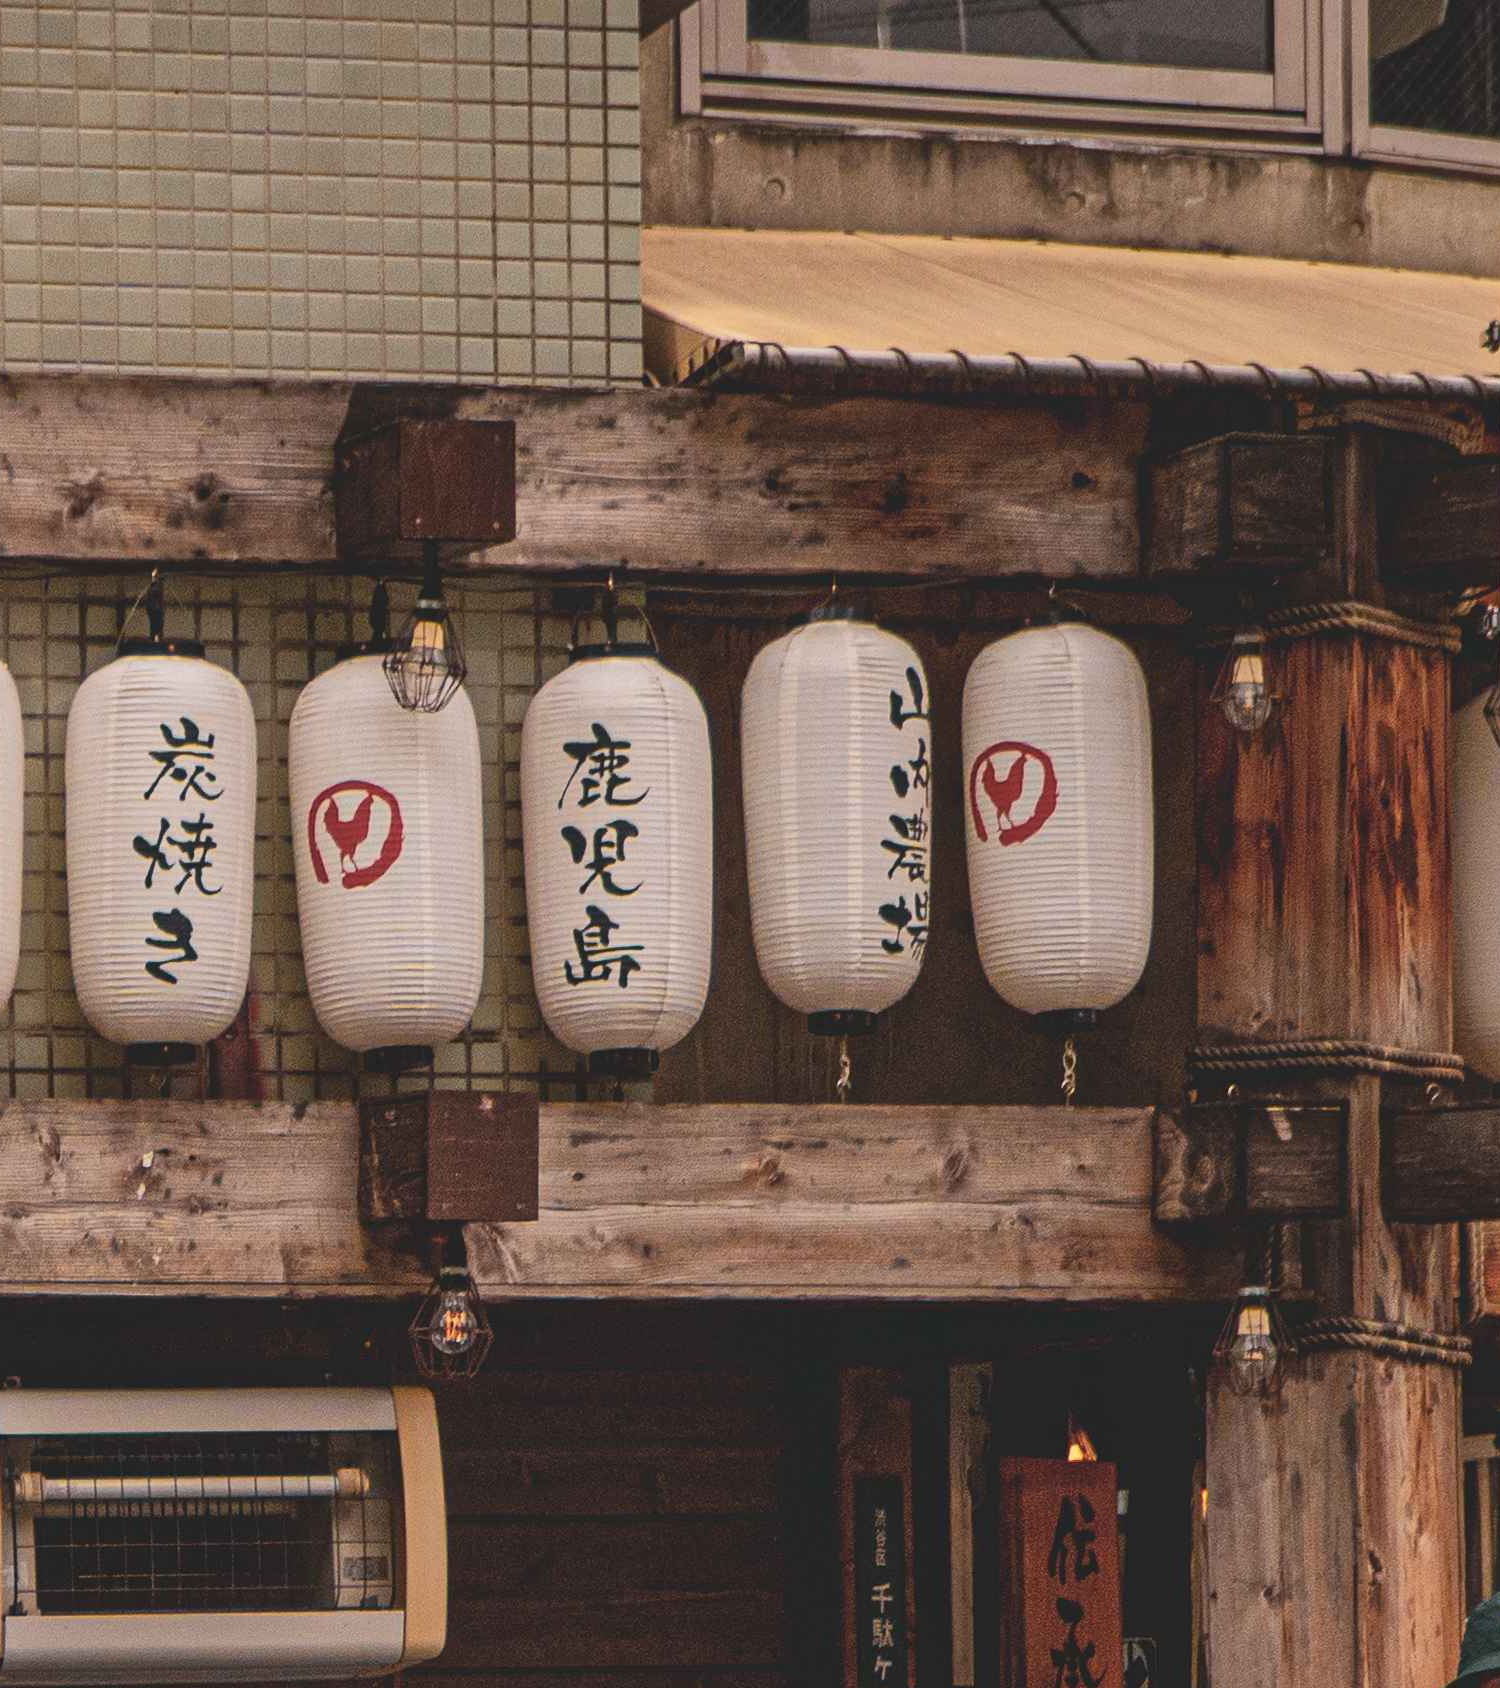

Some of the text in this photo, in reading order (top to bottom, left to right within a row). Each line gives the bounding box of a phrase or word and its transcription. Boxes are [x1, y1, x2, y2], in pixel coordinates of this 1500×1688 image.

[131, 717, 225, 985] 炭焼き
[558, 722, 650, 989] 鹿児島
[878, 664, 932, 962] 山内農場
